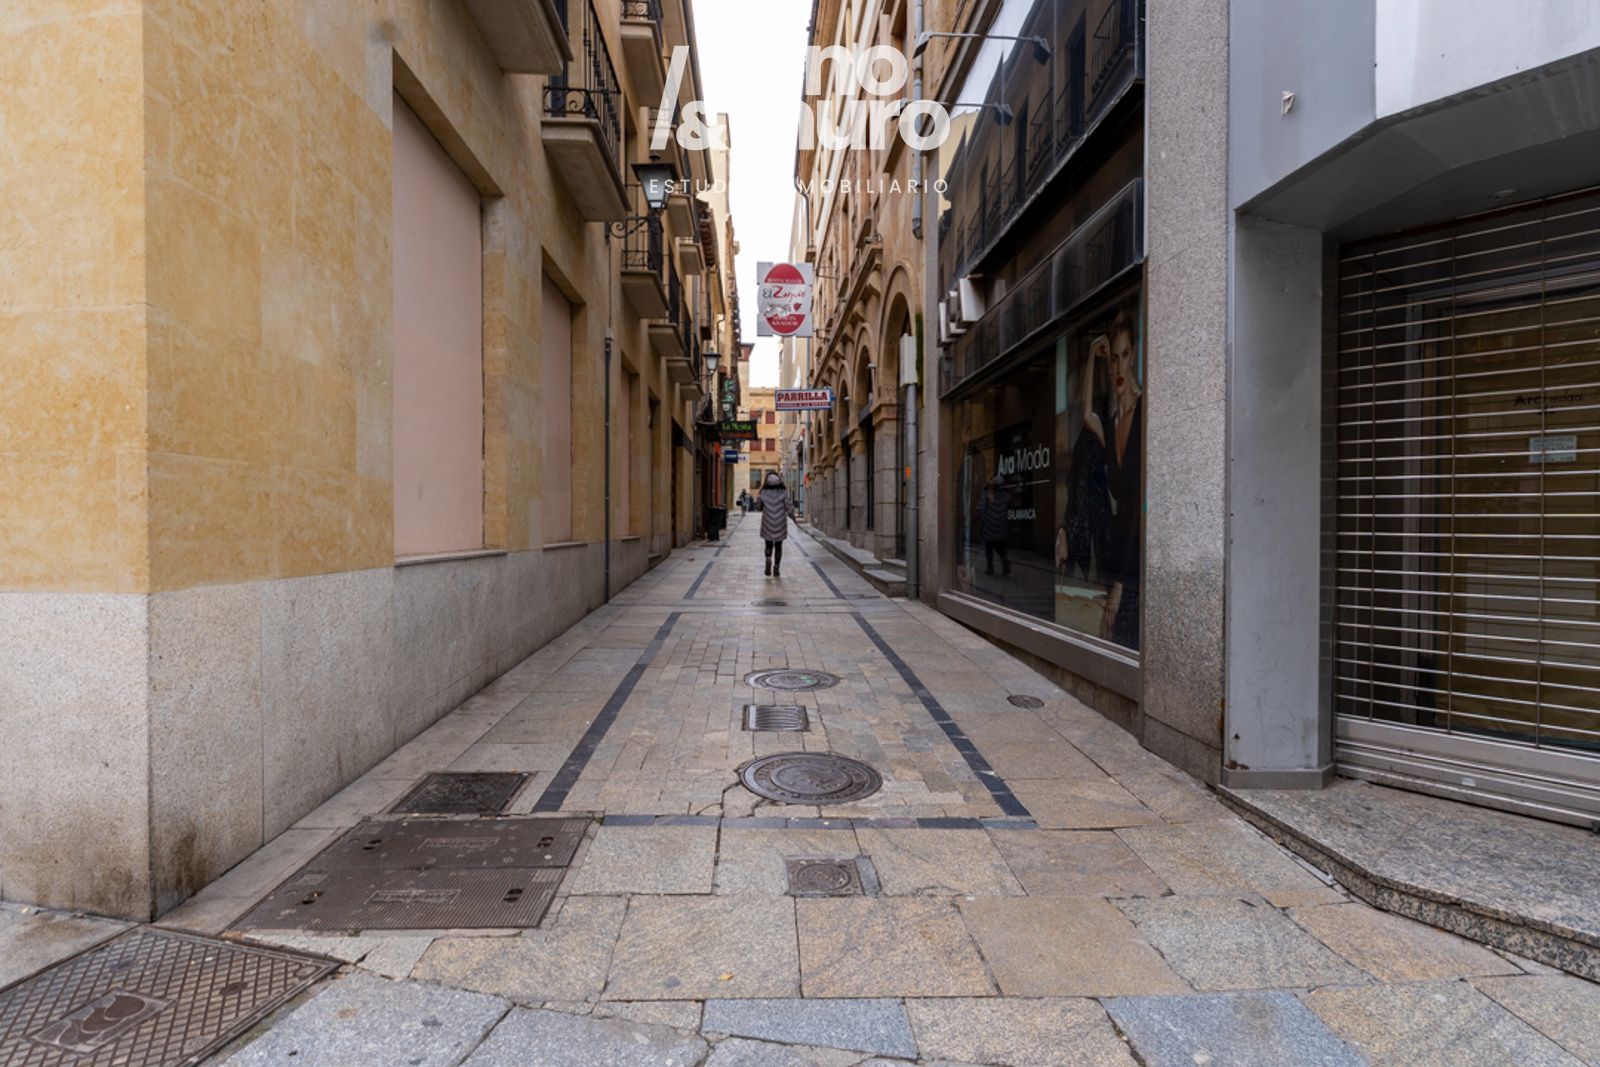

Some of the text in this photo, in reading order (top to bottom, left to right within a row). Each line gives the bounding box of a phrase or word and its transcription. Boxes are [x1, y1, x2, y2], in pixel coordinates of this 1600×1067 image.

[777, 391, 828, 402] PARRILLA
[998, 442, 1050, 477] Ara Moda
